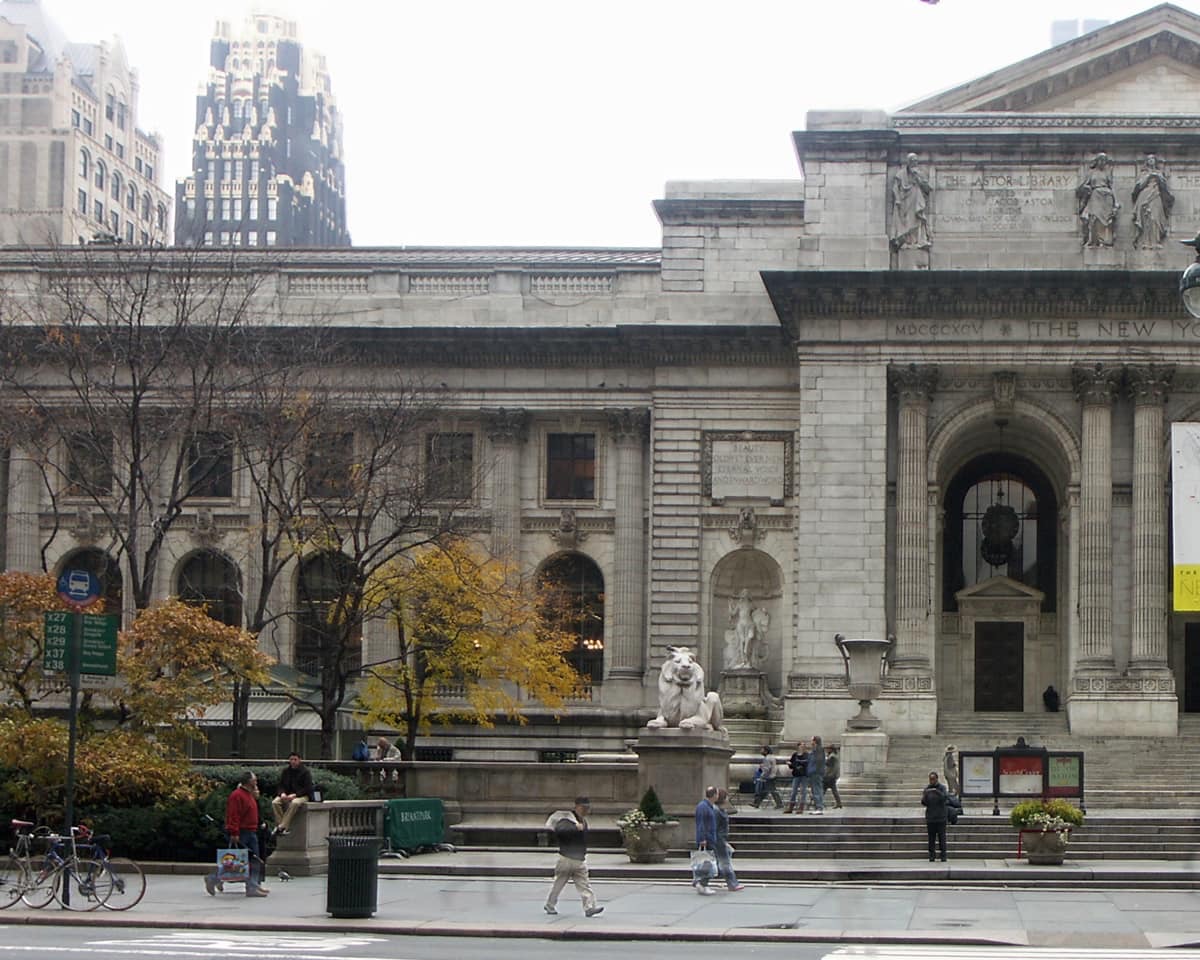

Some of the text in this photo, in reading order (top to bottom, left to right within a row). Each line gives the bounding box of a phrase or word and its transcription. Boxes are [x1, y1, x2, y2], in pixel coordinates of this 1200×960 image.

[943, 175, 1070, 187] THE ASTOR LIBRARY
[1177, 176, 1200, 188] THE
[1030, 321, 1081, 338] THE
[1097, 321, 1156, 338] NEW
